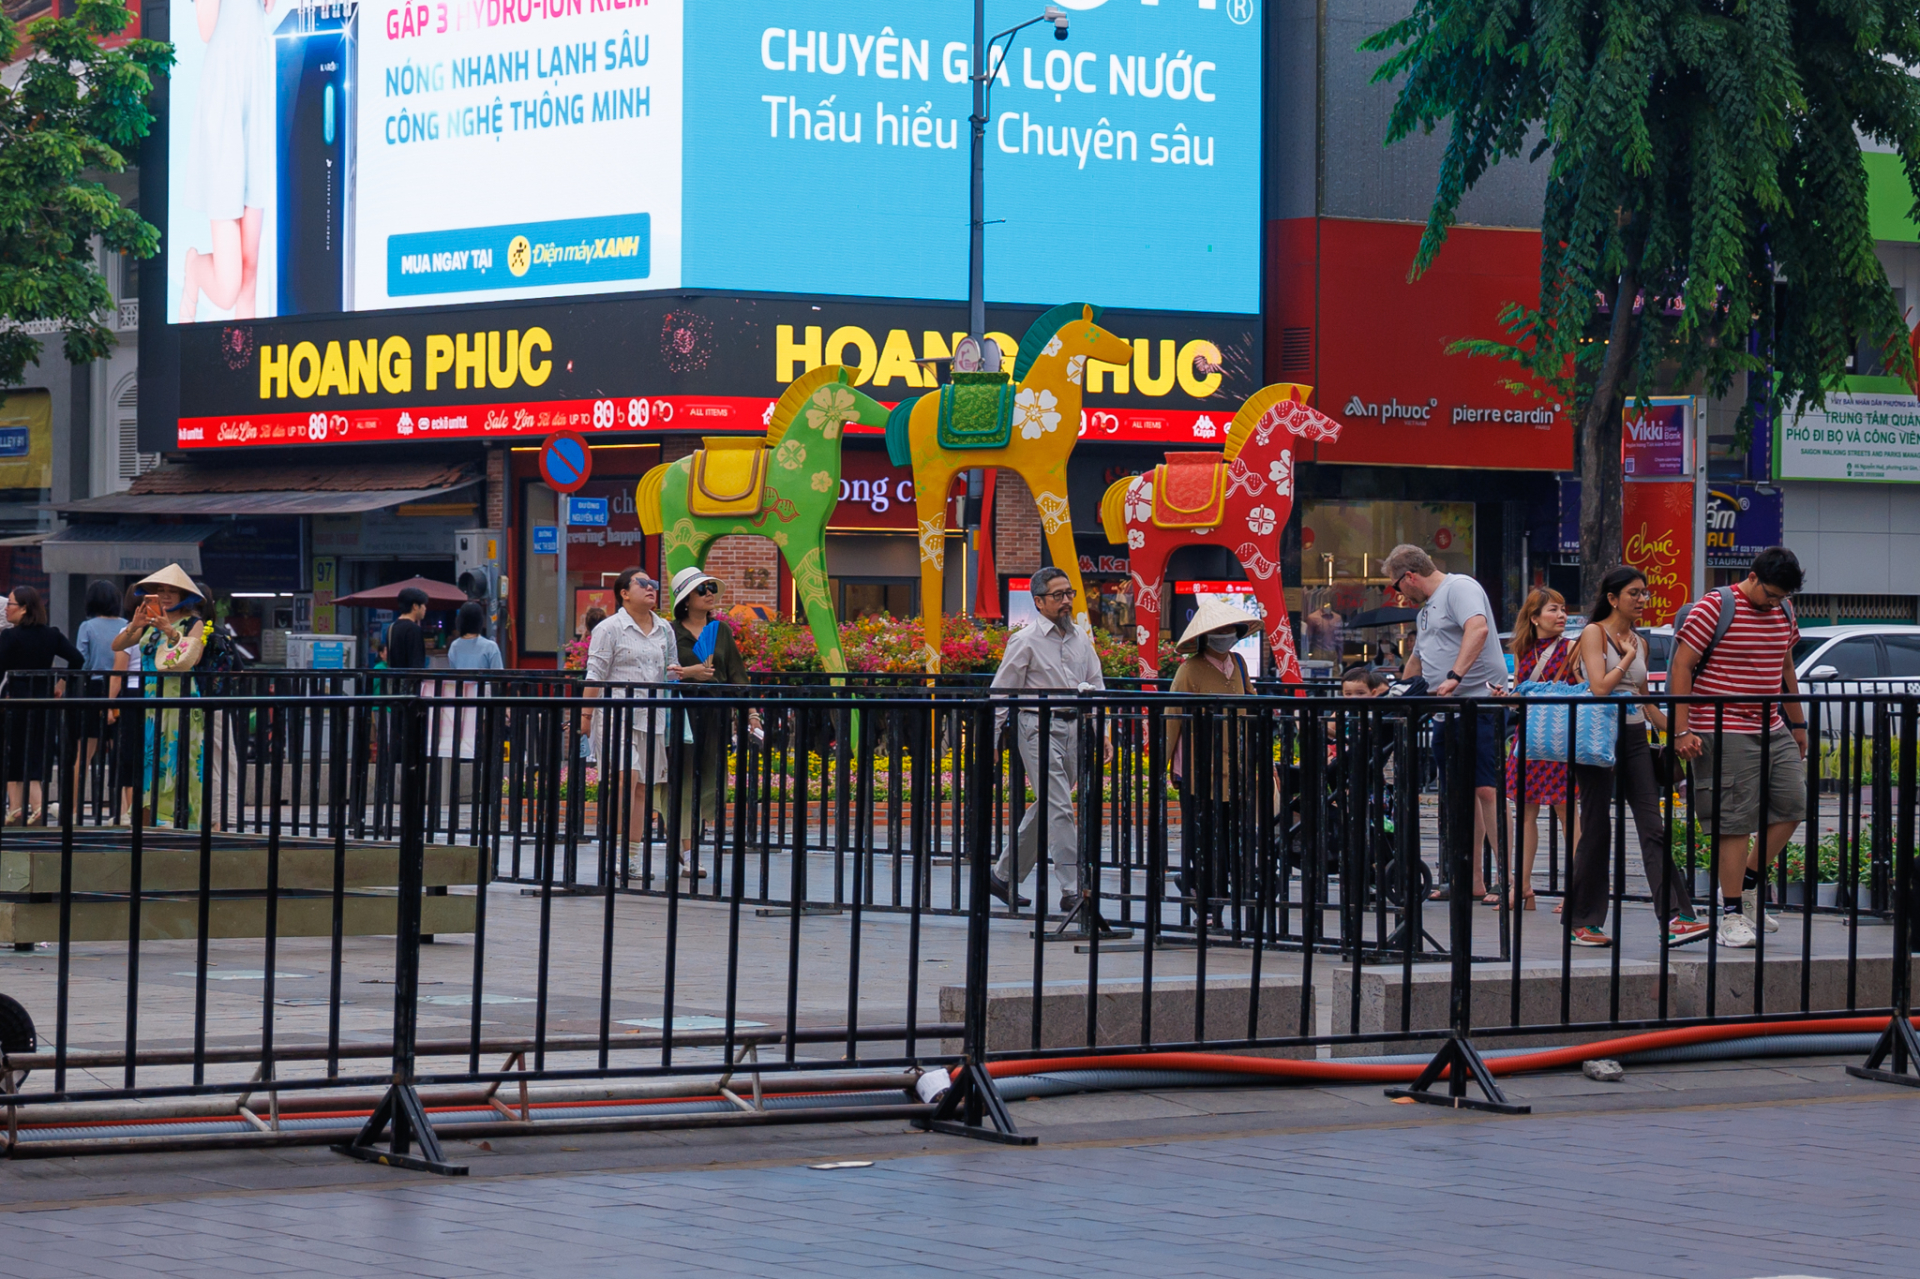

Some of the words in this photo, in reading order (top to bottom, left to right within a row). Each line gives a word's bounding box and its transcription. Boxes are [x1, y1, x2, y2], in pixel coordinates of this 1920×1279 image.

[436, 2, 448, 34] 3
[386, 56, 445, 98] NÓNG
[451, 49, 529, 89] NHANH
[537, 41, 597, 87] LẠNH
[604, 28, 650, 71] SÂU
[760, 25, 929, 82] CHUYÊN
[942, 41, 1011, 87] GA
[1023, 47, 1097, 103] LỌC
[1109, 49, 1216, 102] NƯỚC
[385, 107, 440, 146] CÔNG
[446, 95, 503, 143] NGHỆ
[510, 90, 584, 132] THÔNG
[592, 86, 651, 123] MINH
[761, 94, 862, 144] Thấu
[876, 100, 958, 150] hiểu
[997, 111, 1138, 170] Chuyên
[1150, 122, 1215, 167] sâu
[401, 254, 431, 275] MUA
[432, 251, 468, 273] NGAY
[470, 248, 493, 275] TẠI
[259, 334, 413, 399] HOANG
[425, 326, 553, 391] PHUC
[1086, 338, 1223, 398] HUC
[1381, 397, 1431, 425] phuoc
[1452, 404, 1501, 425] pierre
[1504, 406, 1554, 424] cardin
[1825, 411, 1863, 425] TRUNG
[1865, 410, 1888, 426] TÂM
[217, 421, 238, 442] Sale
[484, 409, 509, 431] Sale
[569, 413, 579, 426] UP
[580, 413, 590, 425] TO
[689, 408, 704, 416] ALL
[1131, 421, 1143, 429] ALL
[1144, 421, 1162, 429] ITEMS
[1193, 427, 1216, 438] Kappa
[1625, 415, 1663, 441] Vikki
[1664, 431, 1681, 440] Bank
[1786, 425, 1811, 441] PHỐ
[1813, 429, 1824, 441] ĐI
[1827, 428, 1844, 445] BỘ
[1846, 427, 1862, 443] VÀ
[1863, 428, 1896, 444] CÔNG
[1800, 448, 1821, 456] SAIGON
[1822, 448, 1847, 457] WALKING
[1847, 449, 1871, 457] STREETS
[1883, 450, 1901, 458] PARKS
[571, 510, 594, 523] NGUYỄN
[566, 528, 606, 547] rewing
[607, 527, 641, 547] happi
[1706, 532, 1735, 548] ALI
[317, 562, 333, 582] 97
[1707, 557, 1753, 566] STAURANT
